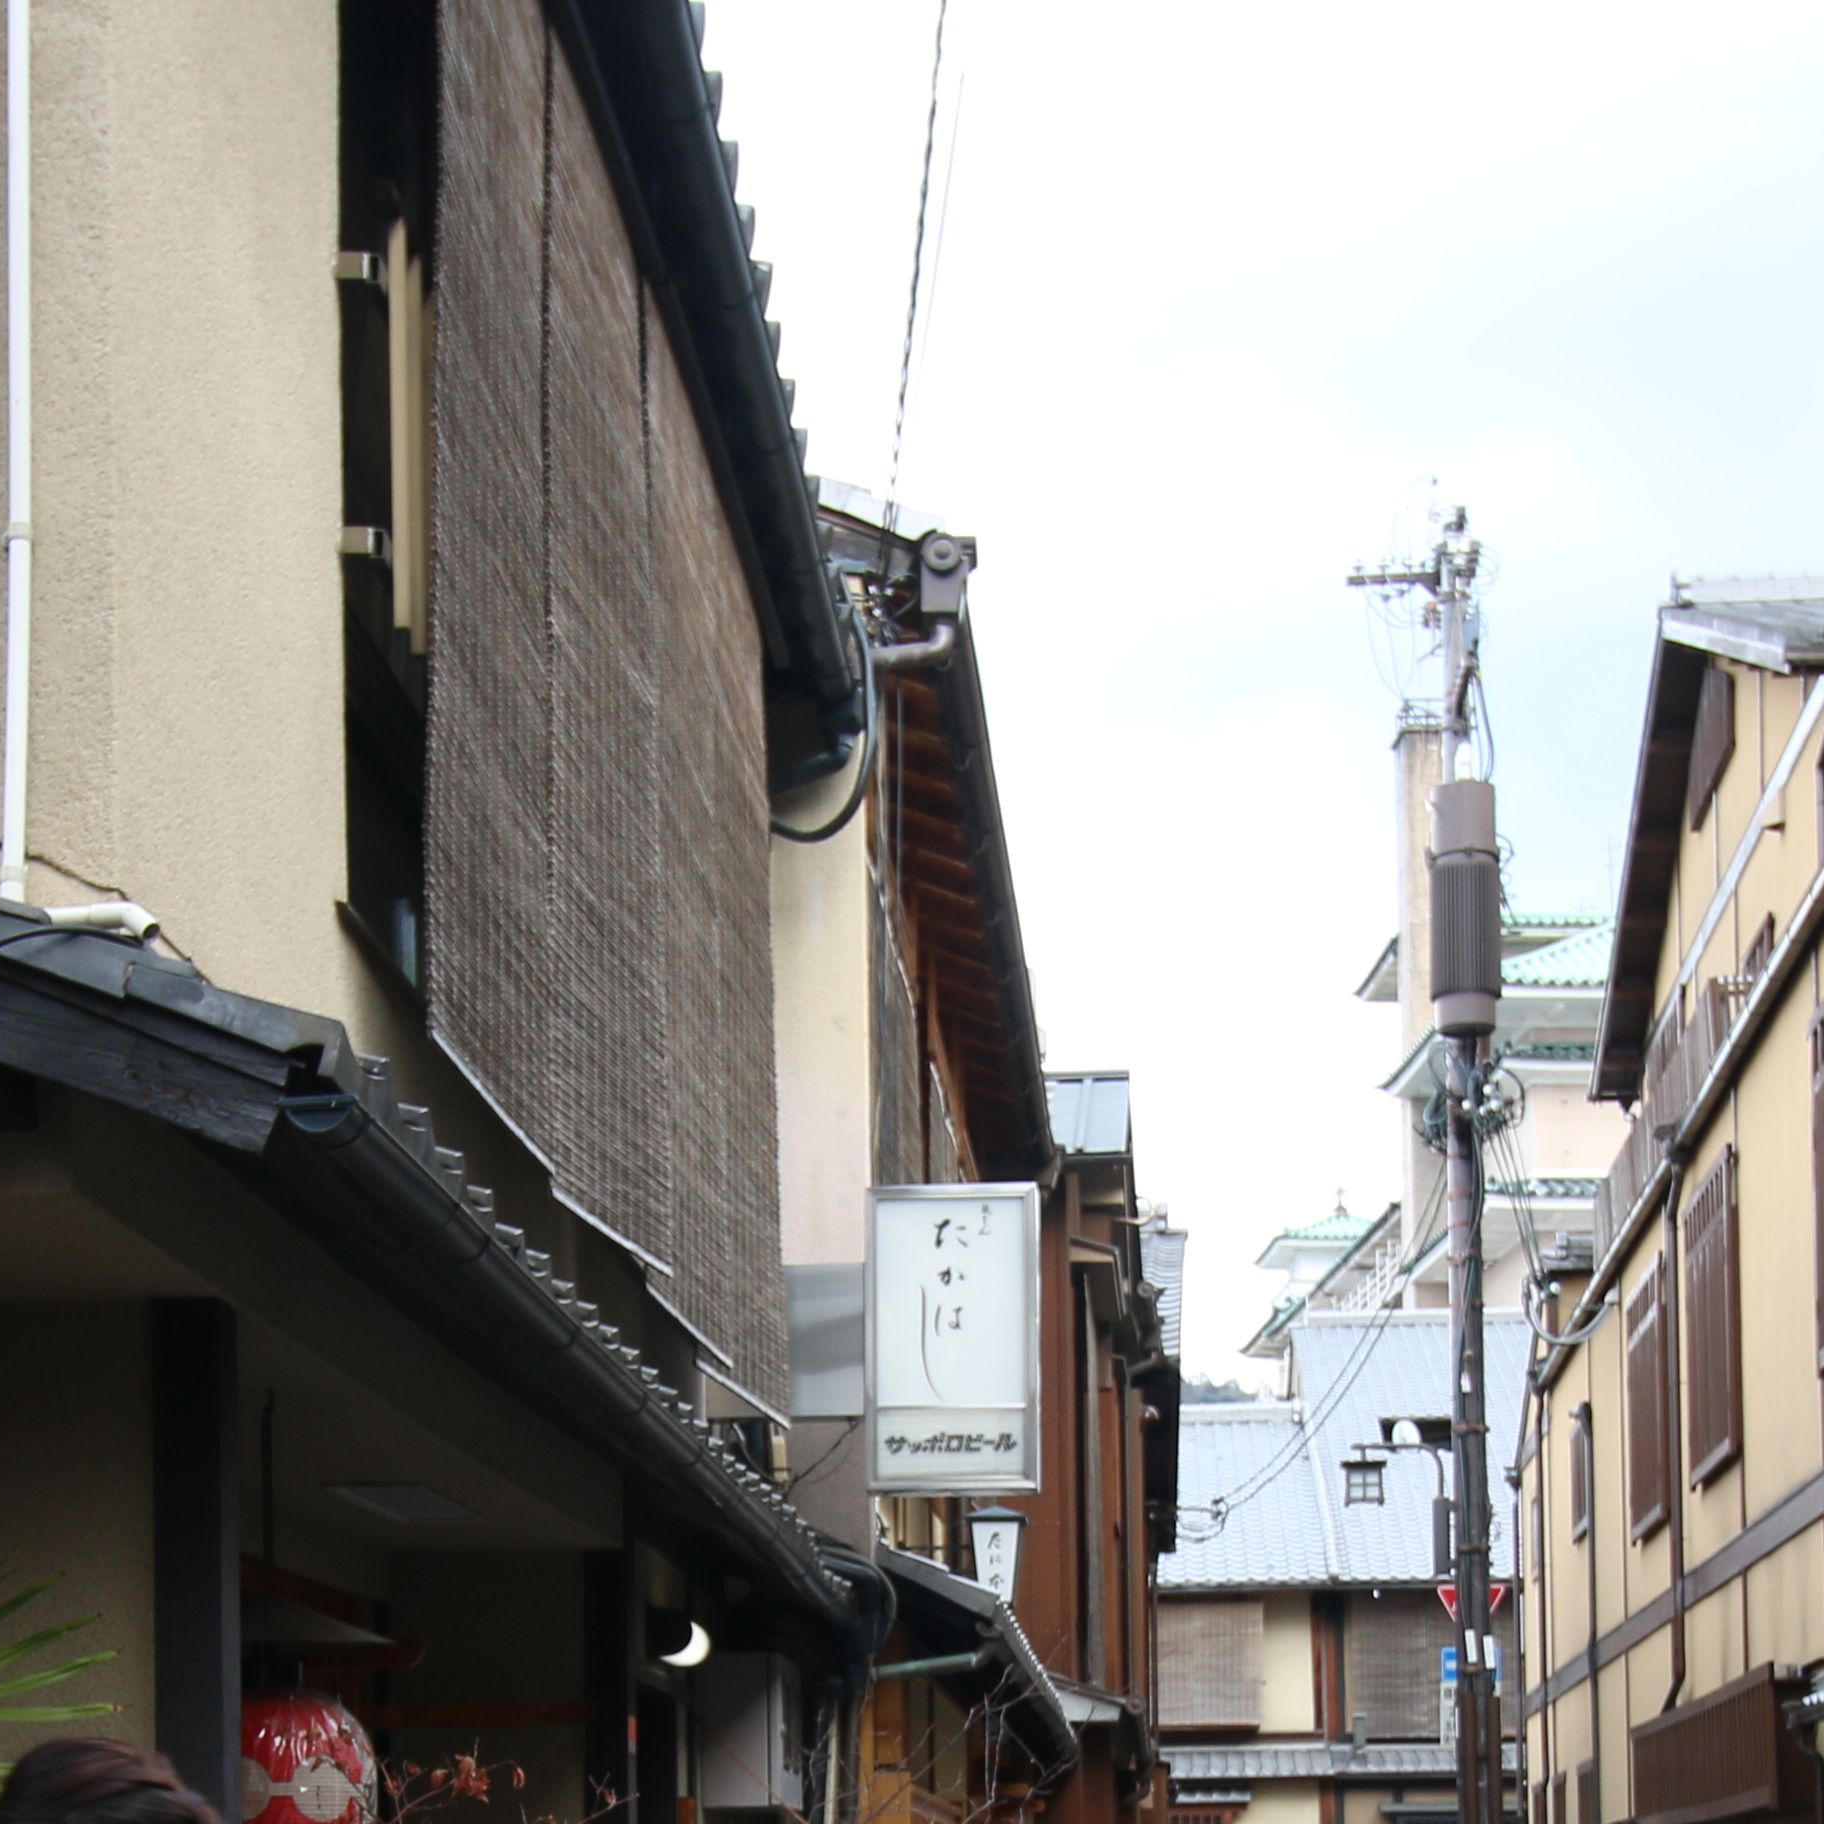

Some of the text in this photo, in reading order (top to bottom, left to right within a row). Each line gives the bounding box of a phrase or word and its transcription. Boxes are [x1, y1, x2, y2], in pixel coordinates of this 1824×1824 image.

[919, 1218, 969, 1403] たかはし
[885, 1431, 1017, 1454] サッポロビール
